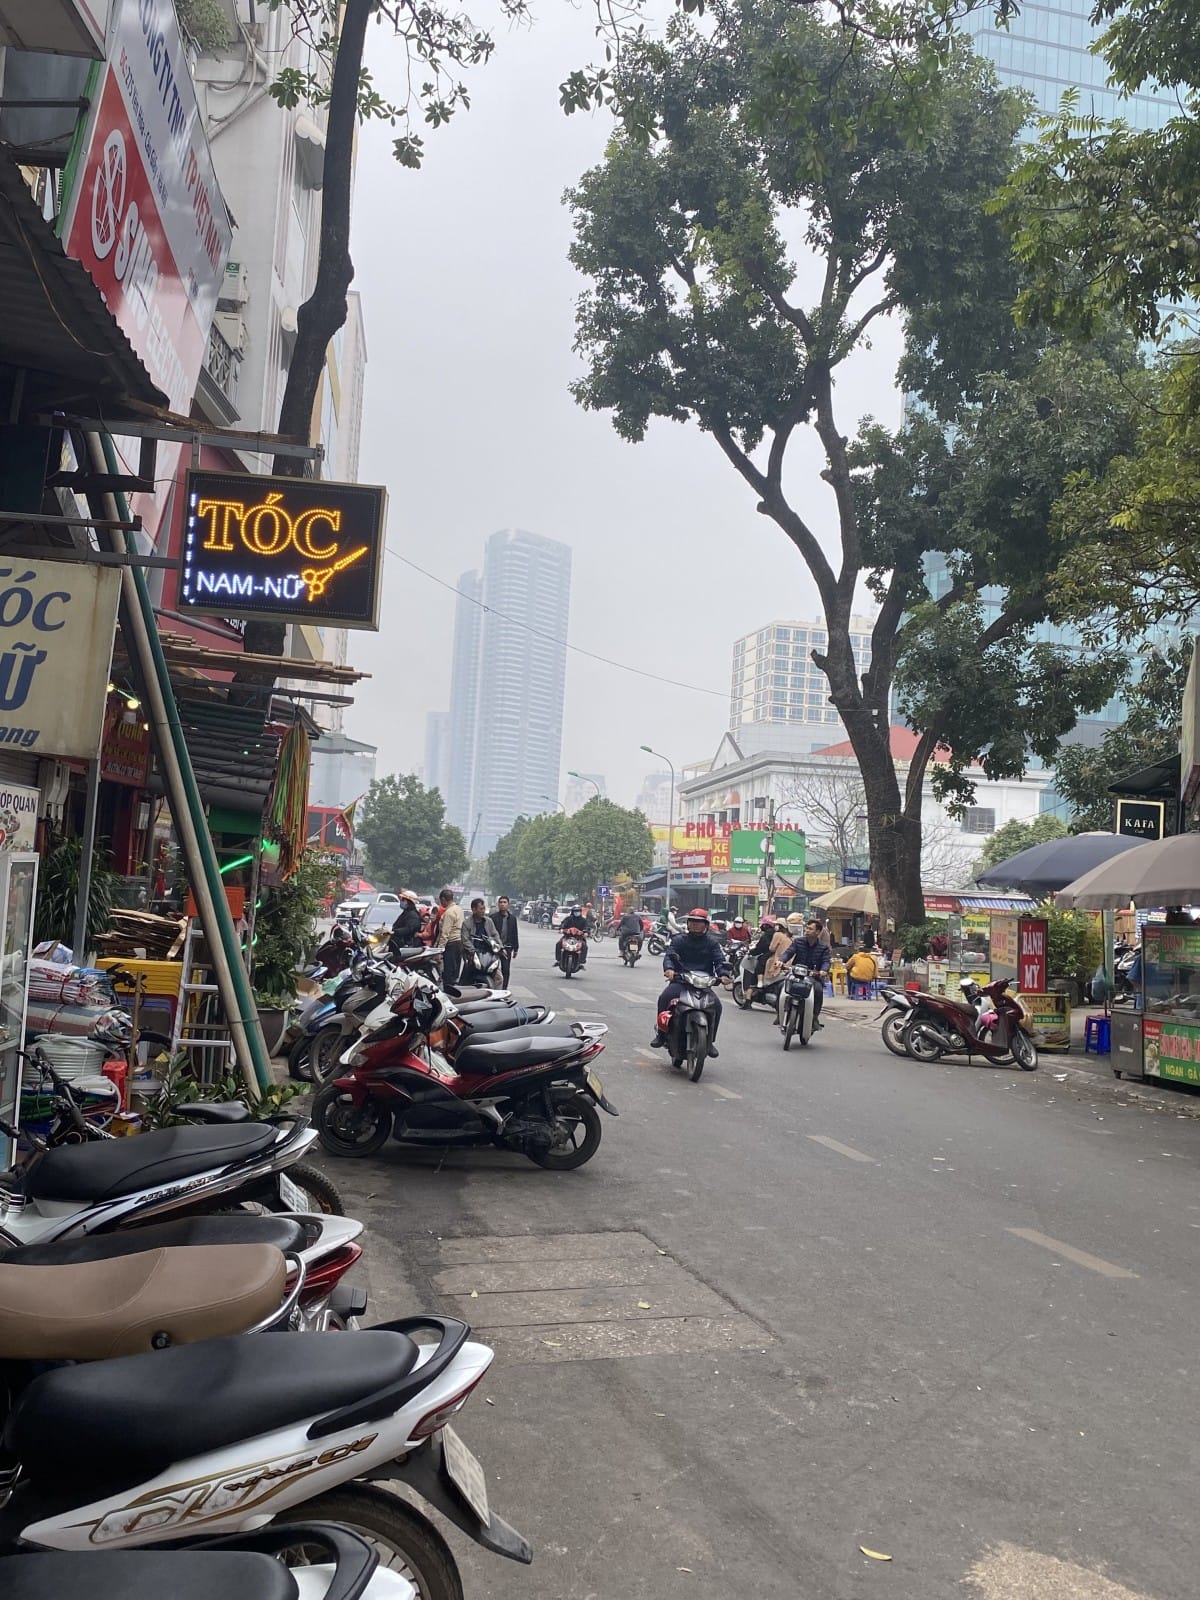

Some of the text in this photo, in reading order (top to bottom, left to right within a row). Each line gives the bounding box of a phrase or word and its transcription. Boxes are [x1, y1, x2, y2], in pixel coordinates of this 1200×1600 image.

[198, 493, 341, 560] TÓC
[1124, 818, 1155, 829] KAFA
[713, 842, 729, 853] XE
[712, 855, 728, 866] GA
[1022, 925, 1043, 956] BÁNH
